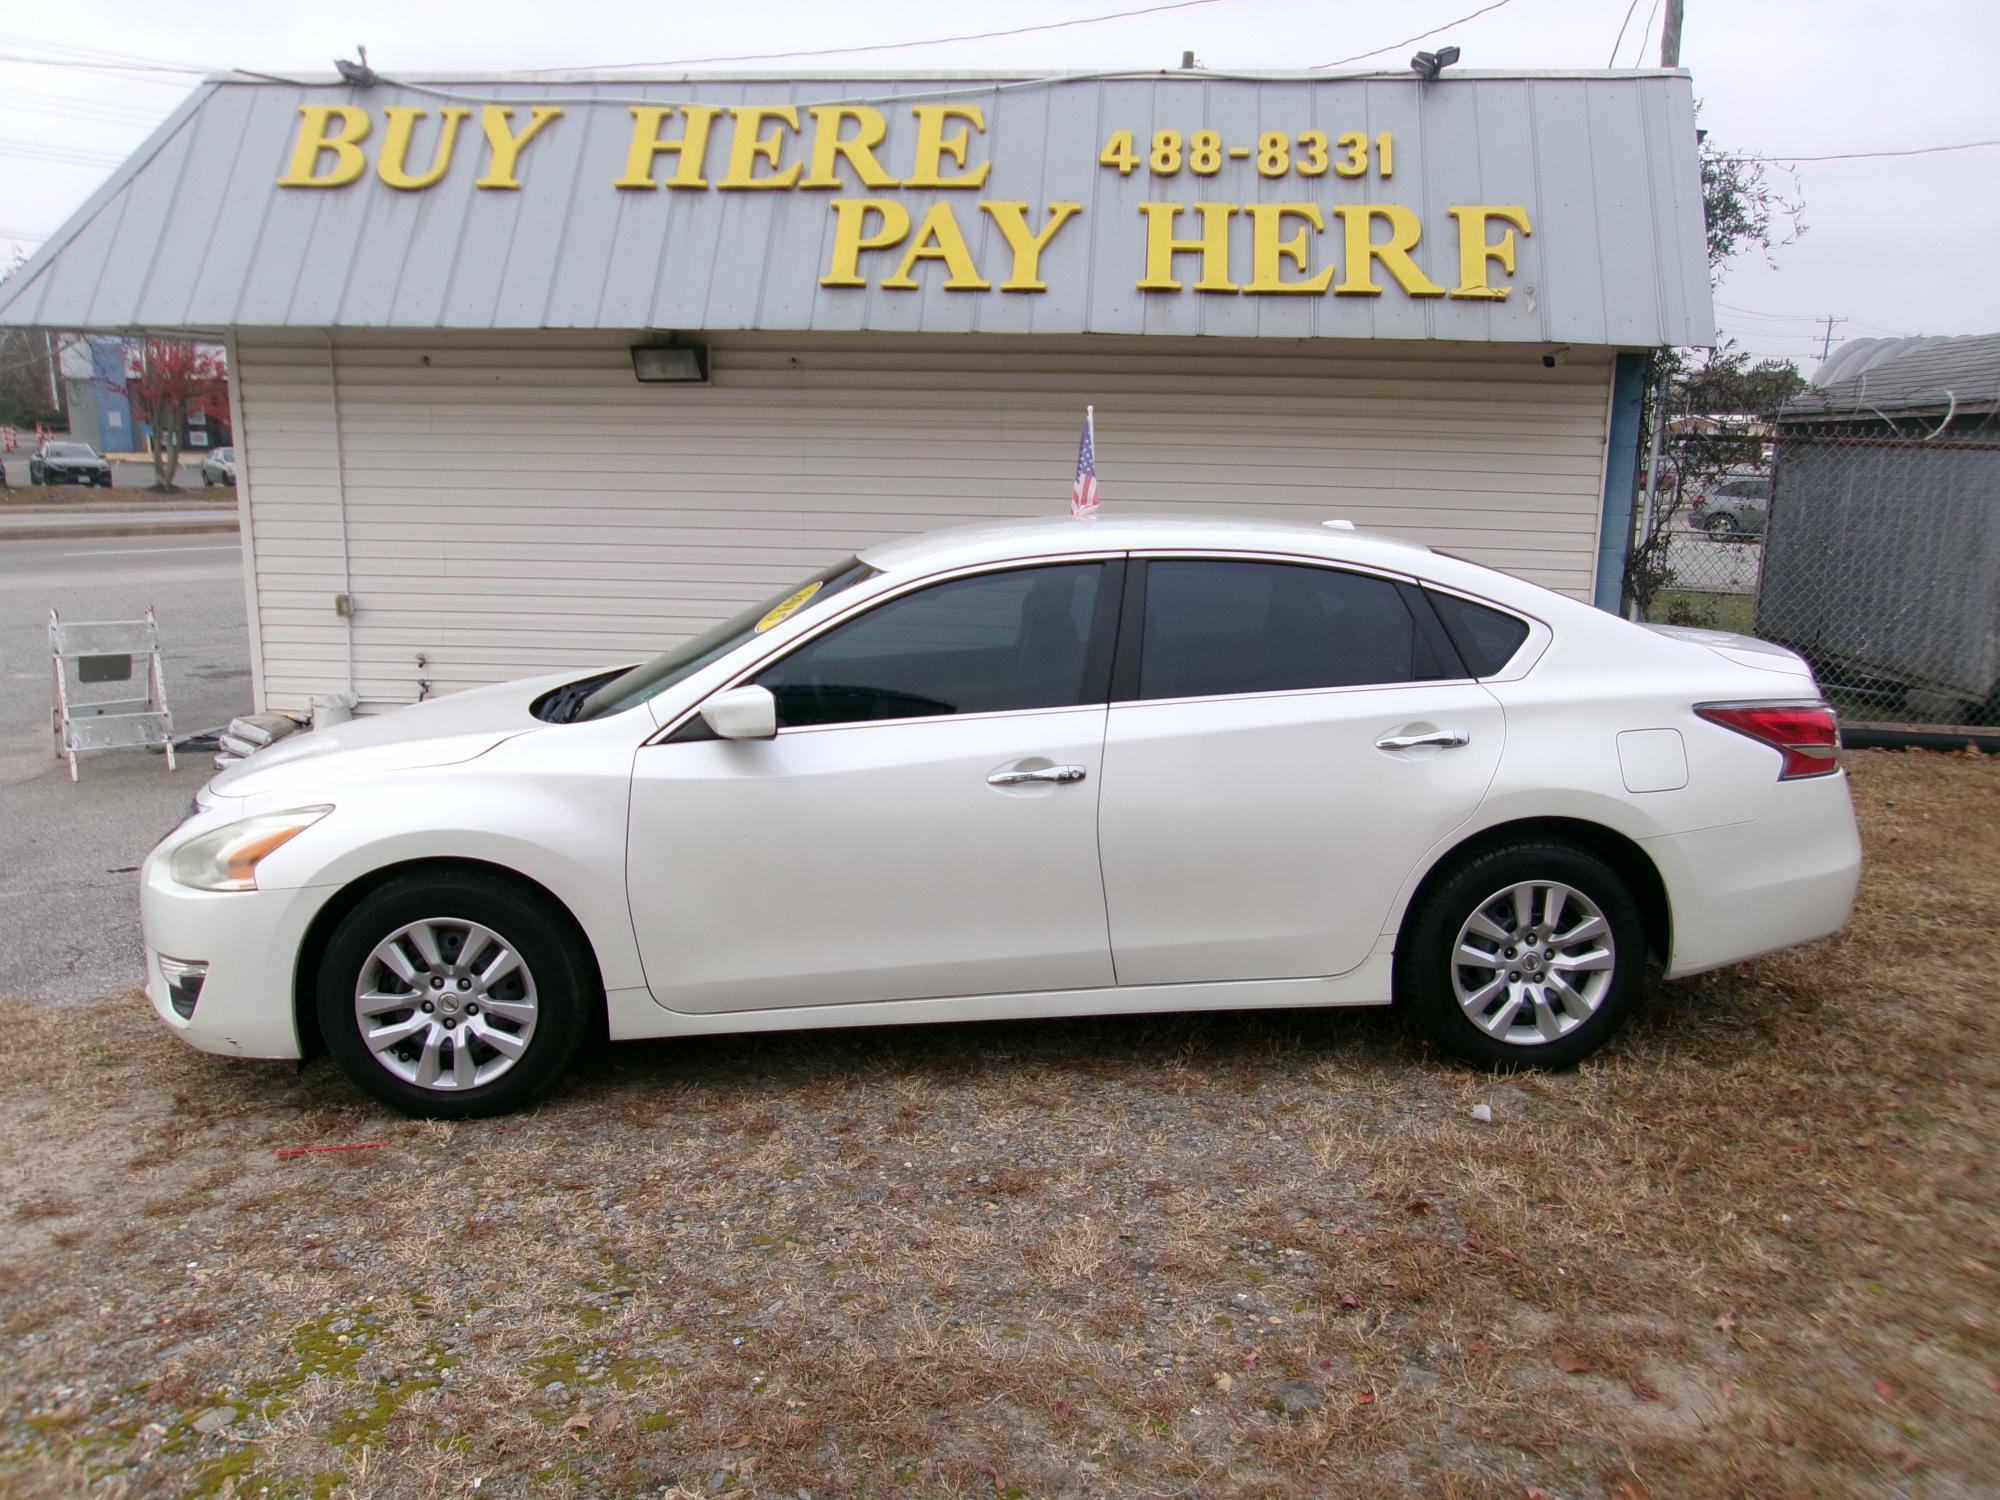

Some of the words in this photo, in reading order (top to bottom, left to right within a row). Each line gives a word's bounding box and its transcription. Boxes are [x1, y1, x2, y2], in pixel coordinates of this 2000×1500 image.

[277, 104, 563, 191] BUY
[614, 104, 993, 190] HERE
[1099, 129, 1394, 177] 488-8331
[820, 198, 1083, 292] PAY
